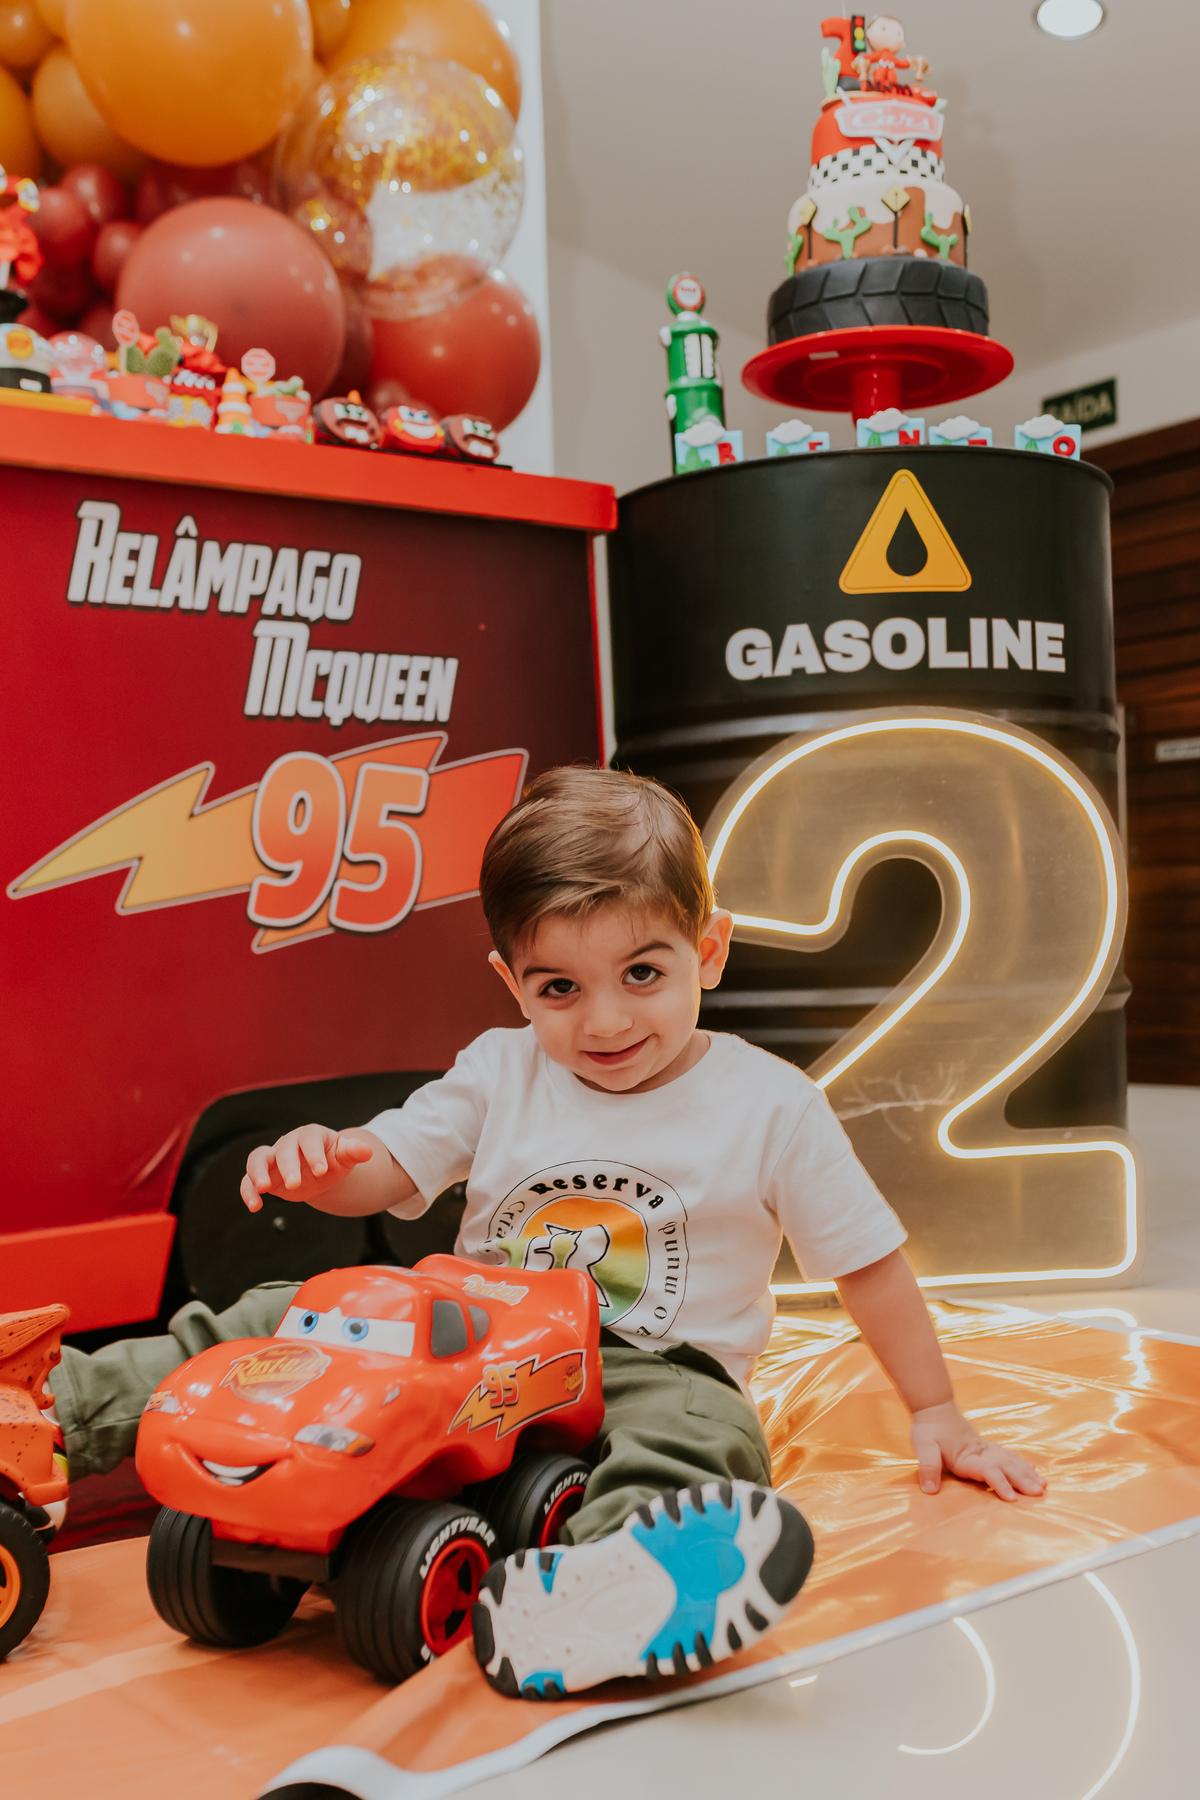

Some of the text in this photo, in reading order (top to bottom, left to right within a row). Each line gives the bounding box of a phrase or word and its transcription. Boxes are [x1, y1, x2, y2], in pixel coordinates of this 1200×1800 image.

[851, 104, 932, 131] Cars
[66, 499, 362, 622] RELÂMPAGO
[724, 617, 1066, 681] GASOLINE
[246, 751, 430, 933] 95
[702, 716, 1139, 1298] 2
[528, 1173, 665, 1210] Reserva
[482, 1360, 519, 1408] 95
[543, 1471, 590, 1515] LIGHTY
[419, 1515, 496, 1580] LIGHTYEAR
